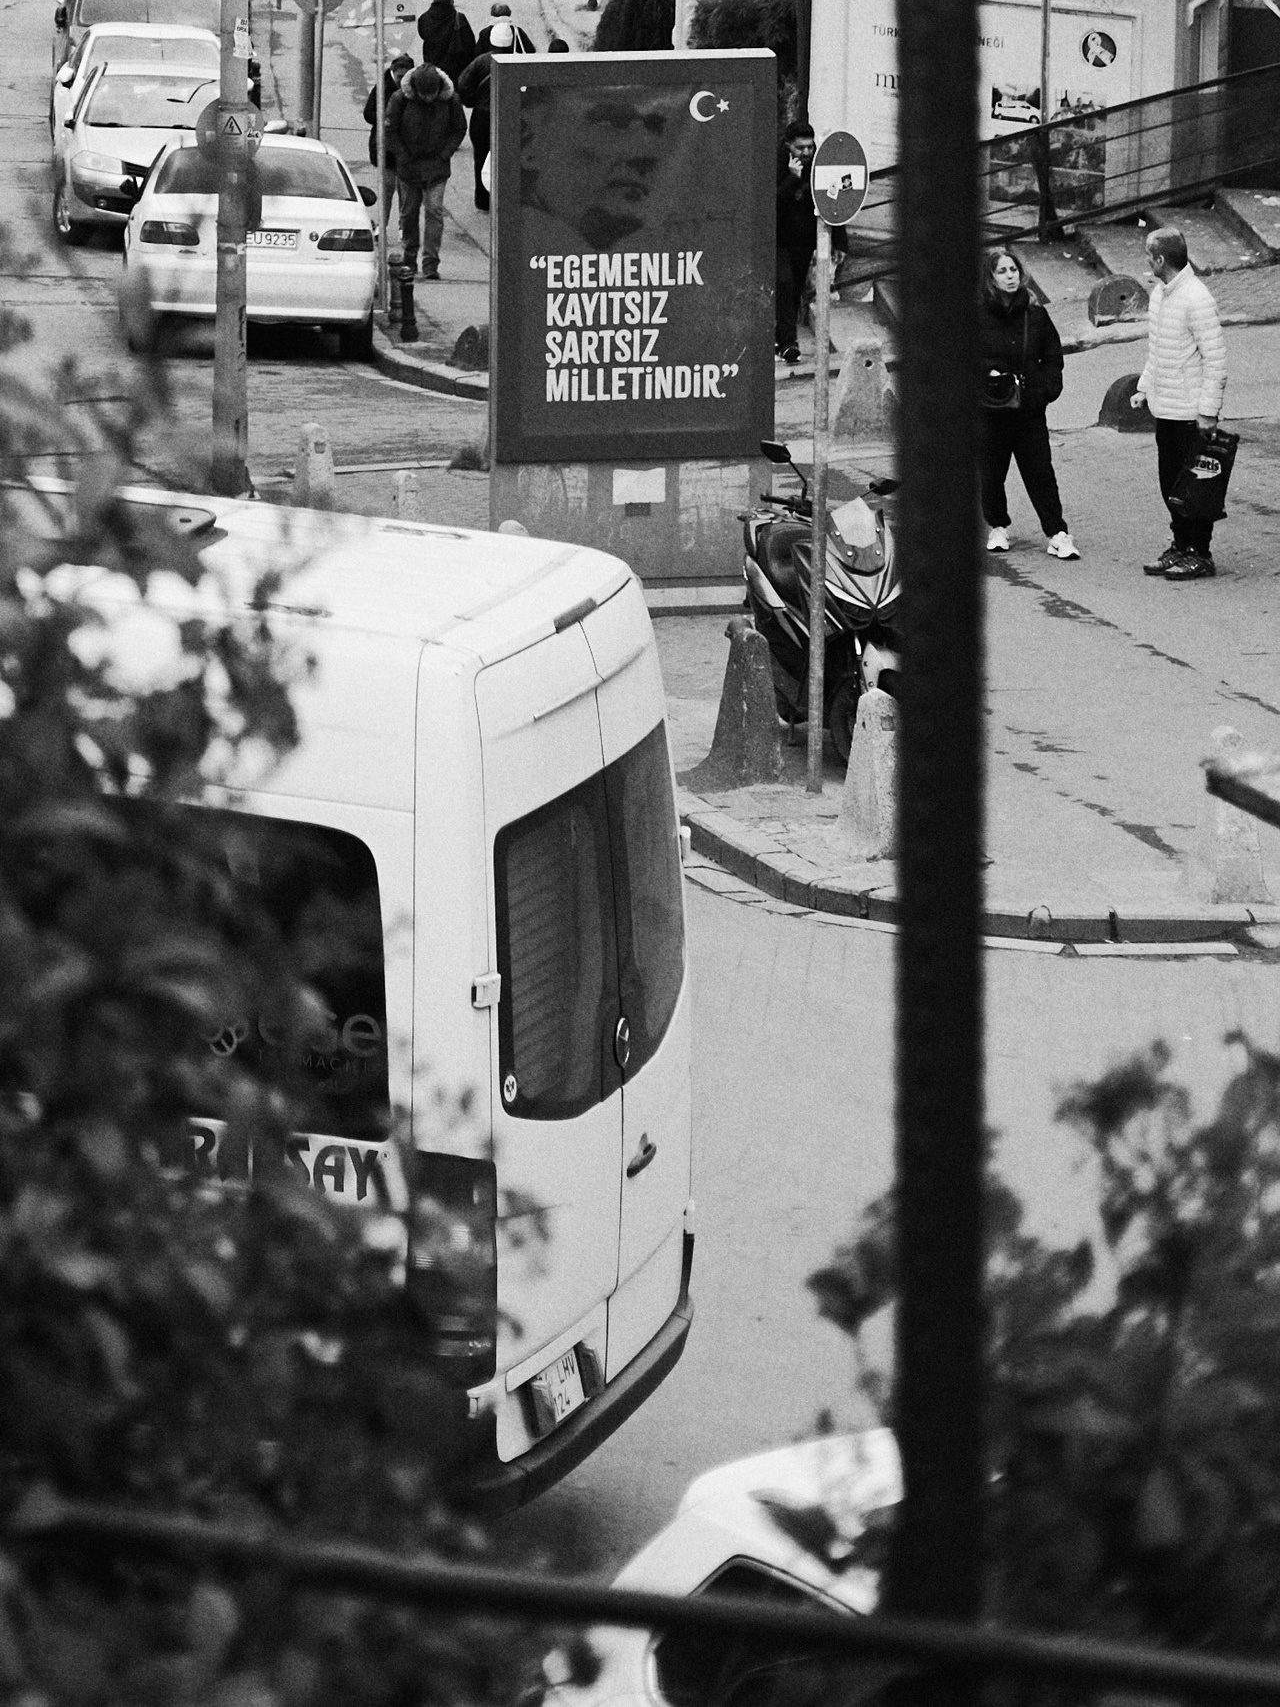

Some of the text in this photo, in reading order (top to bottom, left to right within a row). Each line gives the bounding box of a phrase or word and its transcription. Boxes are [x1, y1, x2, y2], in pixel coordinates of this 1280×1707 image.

[265, 233, 296, 246] 9235
[546, 290, 669, 328] KAYITSIZ
[545, 328, 660, 368] ŞARTSIZ
[186, 1126, 379, 1201] RSAY
